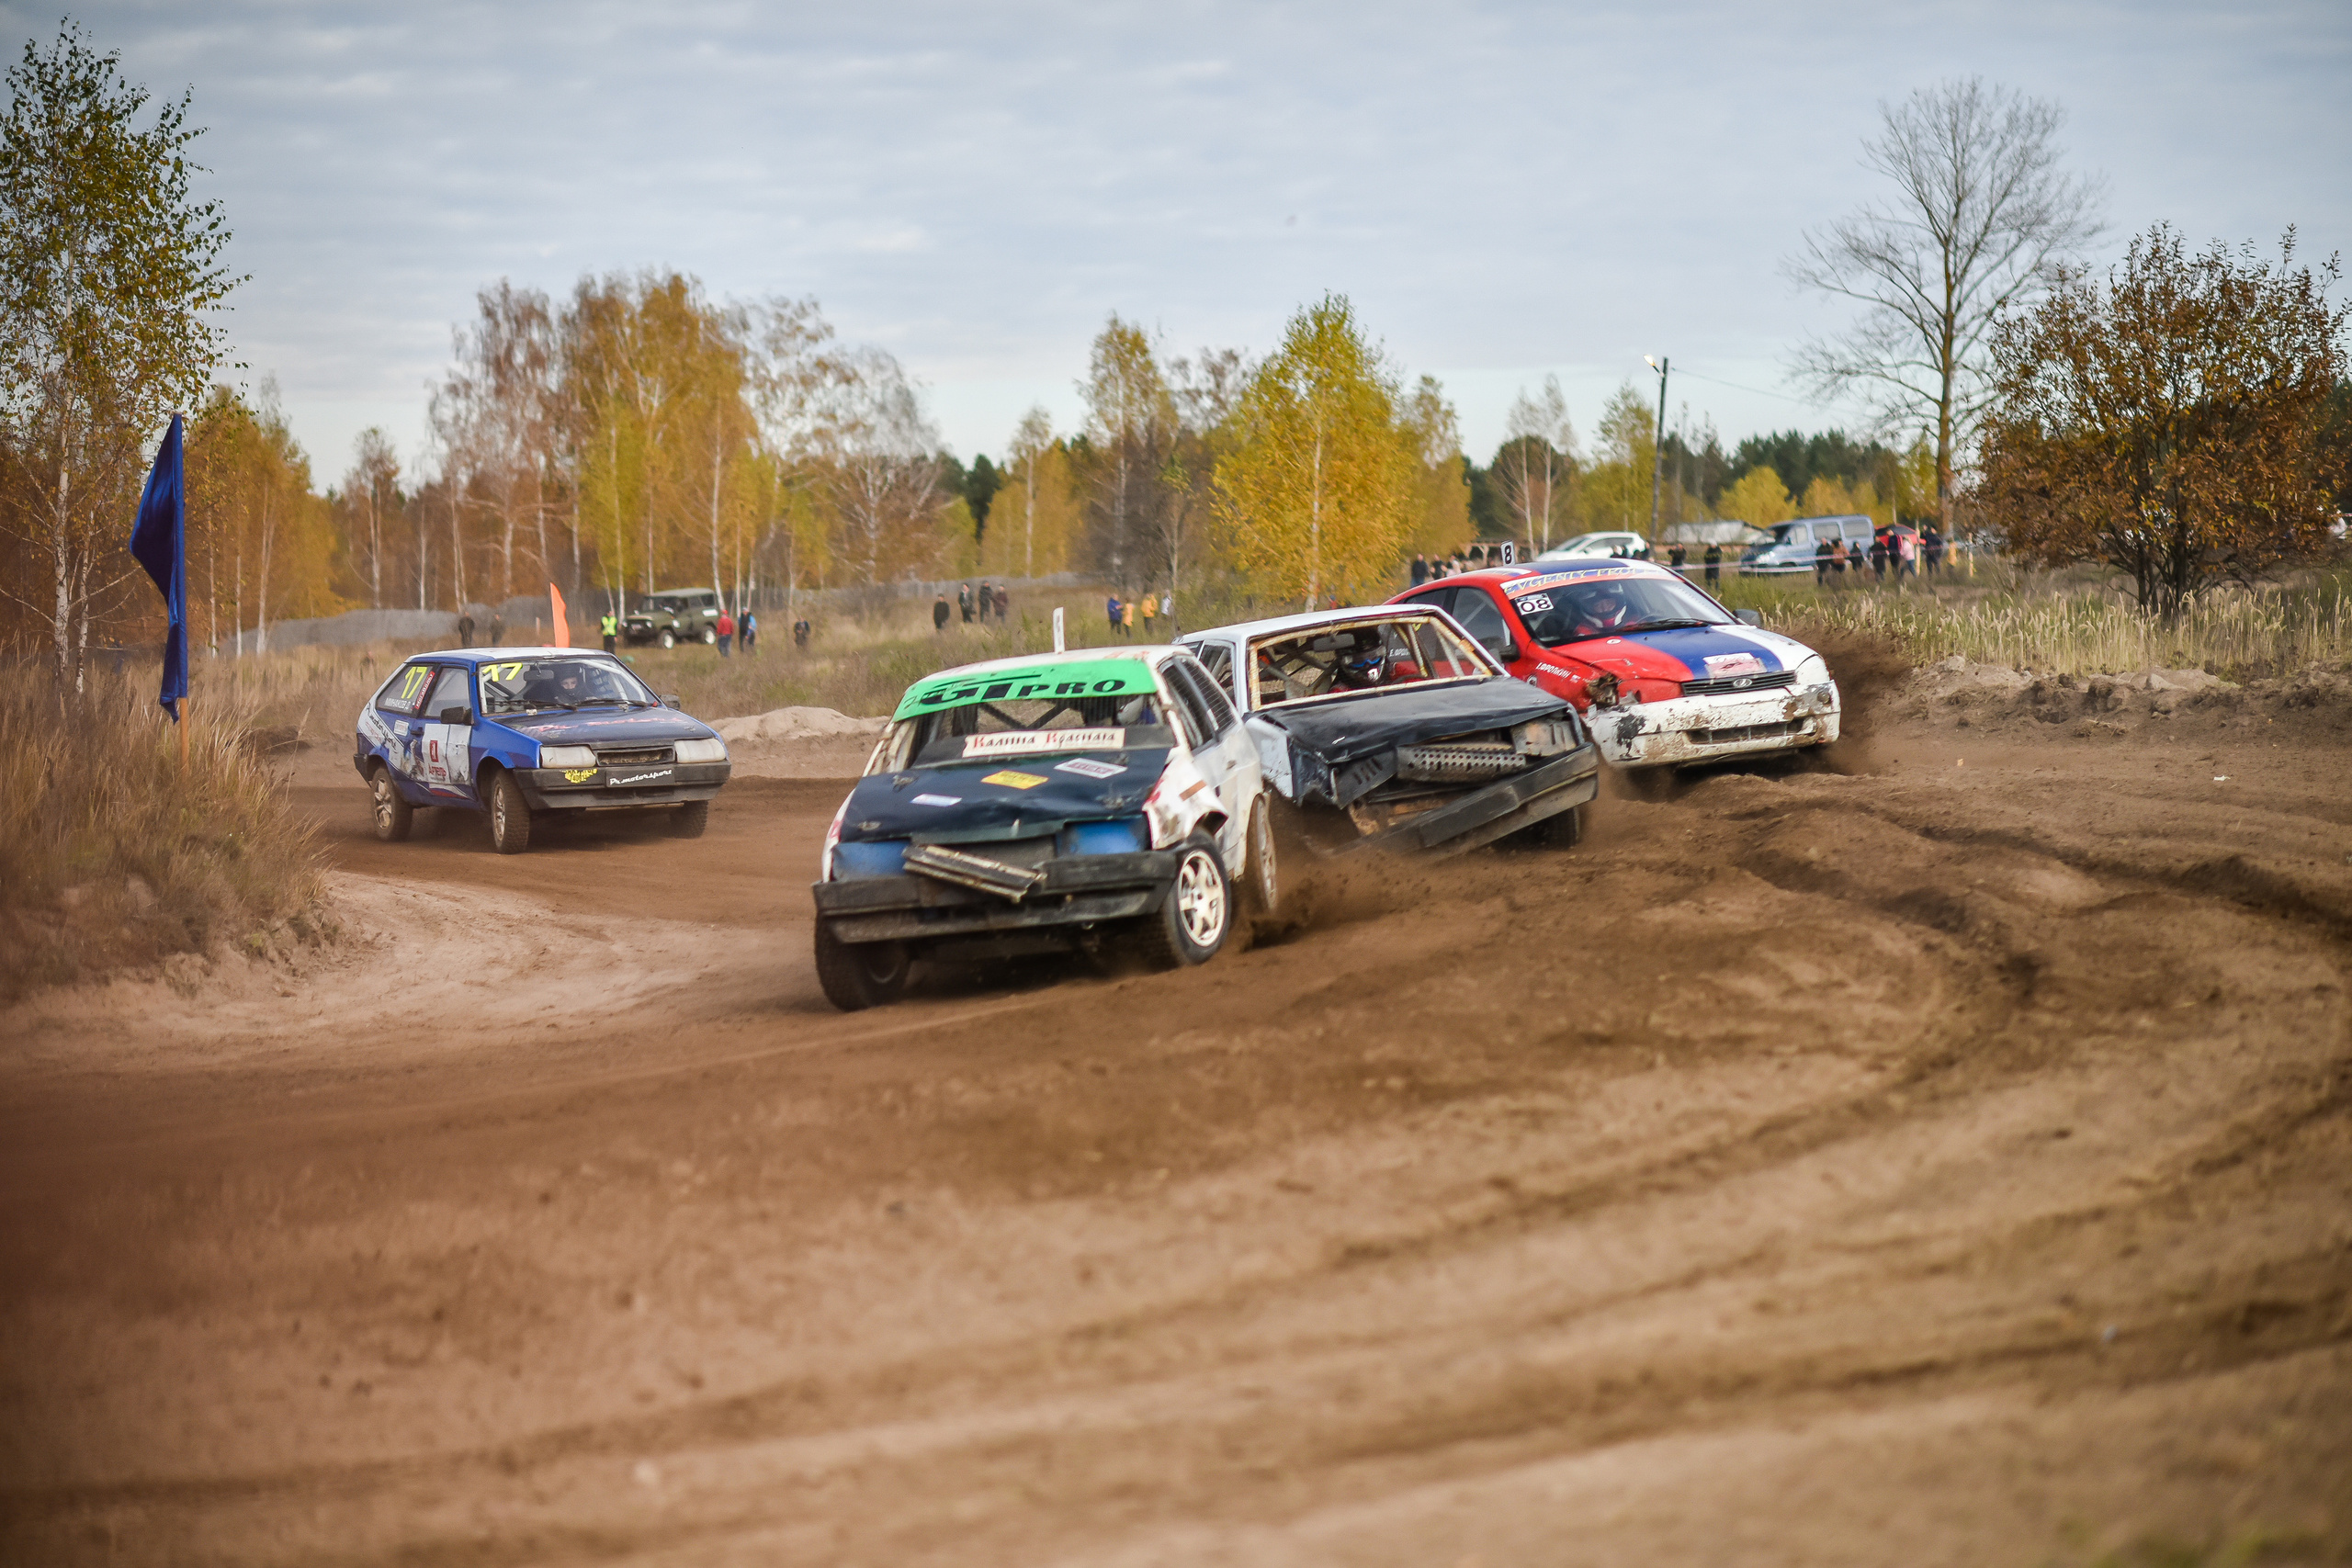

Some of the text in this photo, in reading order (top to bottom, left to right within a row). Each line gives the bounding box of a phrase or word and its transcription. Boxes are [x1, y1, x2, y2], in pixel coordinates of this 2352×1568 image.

[1504, 545, 1512, 565] 8
[1503, 570, 1591, 595] EVGENIY
[1520, 598, 1551, 613] 08
[481, 662, 523, 682] 17
[401, 666, 428, 699] 17
